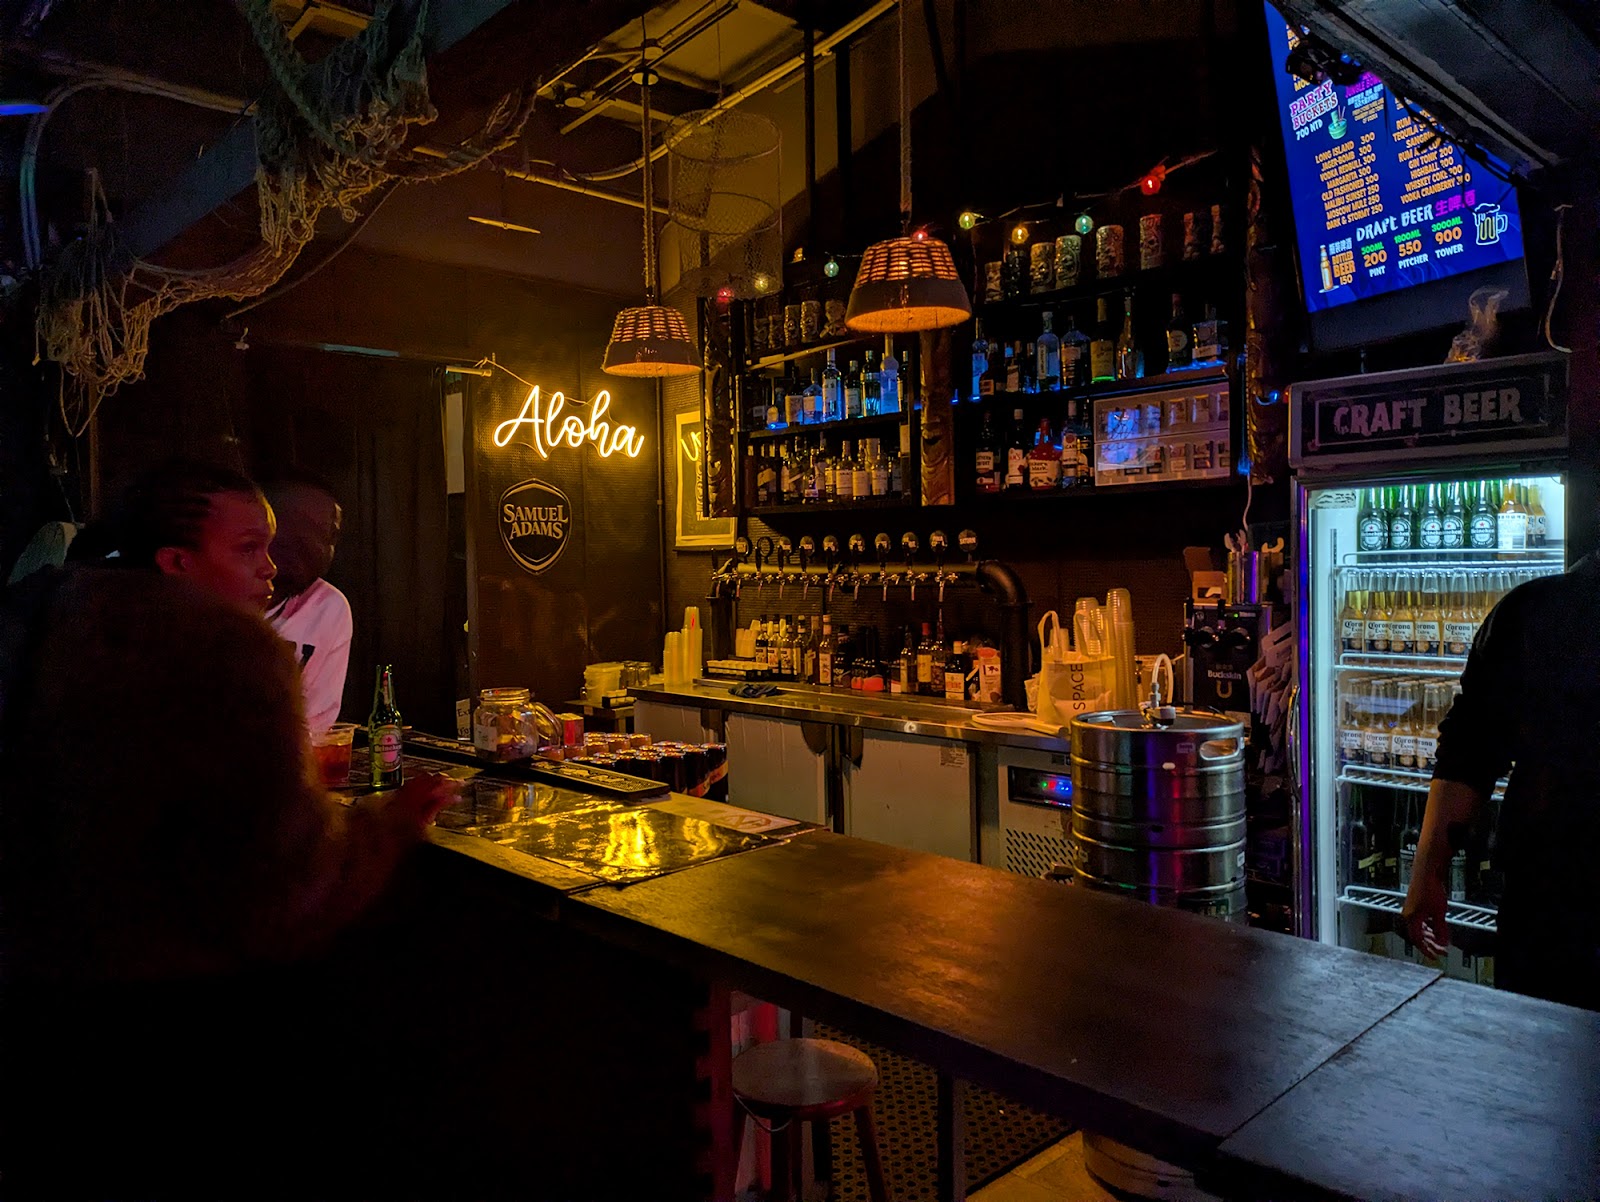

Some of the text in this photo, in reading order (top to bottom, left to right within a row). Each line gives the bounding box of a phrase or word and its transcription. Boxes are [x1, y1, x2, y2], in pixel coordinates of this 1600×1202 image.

[1289, 79, 1333, 117] PARTY
[1291, 92, 1338, 131] BUCKETS
[1296, 119, 1323, 140] 700 NTD
[1392, 124, 1419, 142] TEQUILA
[1315, 132, 1375, 164] LONG ISLAND 300
[1359, 144, 1372, 156] 300
[1398, 149, 1413, 163] RUM
[1408, 158, 1419, 169] GIN
[1439, 145, 1453, 158] 200
[1320, 153, 1376, 182] VODKA REDBULL 300
[1327, 165, 1371, 189] MARGARITA 300
[1410, 162, 1440, 180] HIGHBALL
[1321, 173, 1379, 201] OLD FASHIONED 300
[1400, 190, 1421, 204] VODKA
[1421, 178, 1456, 197] CRANBERRY
[1405, 175, 1431, 192] WHISKEY
[1324, 183, 1379, 211] MALIBU SUNSET 250
[1326, 194, 1380, 220] MOSCOW MULE 250
[1326, 218, 1341, 230] DARK
[1347, 207, 1370, 223] STORMY
[1371, 203, 1383, 215] 250
[1401, 203, 1434, 227] BEER
[1431, 216, 1463, 233] 3000ML
[1435, 226, 1462, 245] 900
[1331, 250, 1354, 265] BOTTLED
[1398, 239, 1422, 257] 550
[1434, 243, 1464, 259] TOWER
[1333, 260, 1356, 278] BEER
[1363, 250, 1388, 268] 200
[1398, 253, 1429, 270] PITCHER
[1339, 274, 1353, 285] 150
[1369, 265, 1386, 278] PINT
[493, 385, 645, 459] Aloha
[1333, 387, 1523, 437] CRAFT BEER
[503, 503, 569, 524] SAMUEL
[509, 521, 563, 541] ADAMS
[1445, 622, 1471, 631] Corona
[1071, 664, 1086, 710] SPACE
